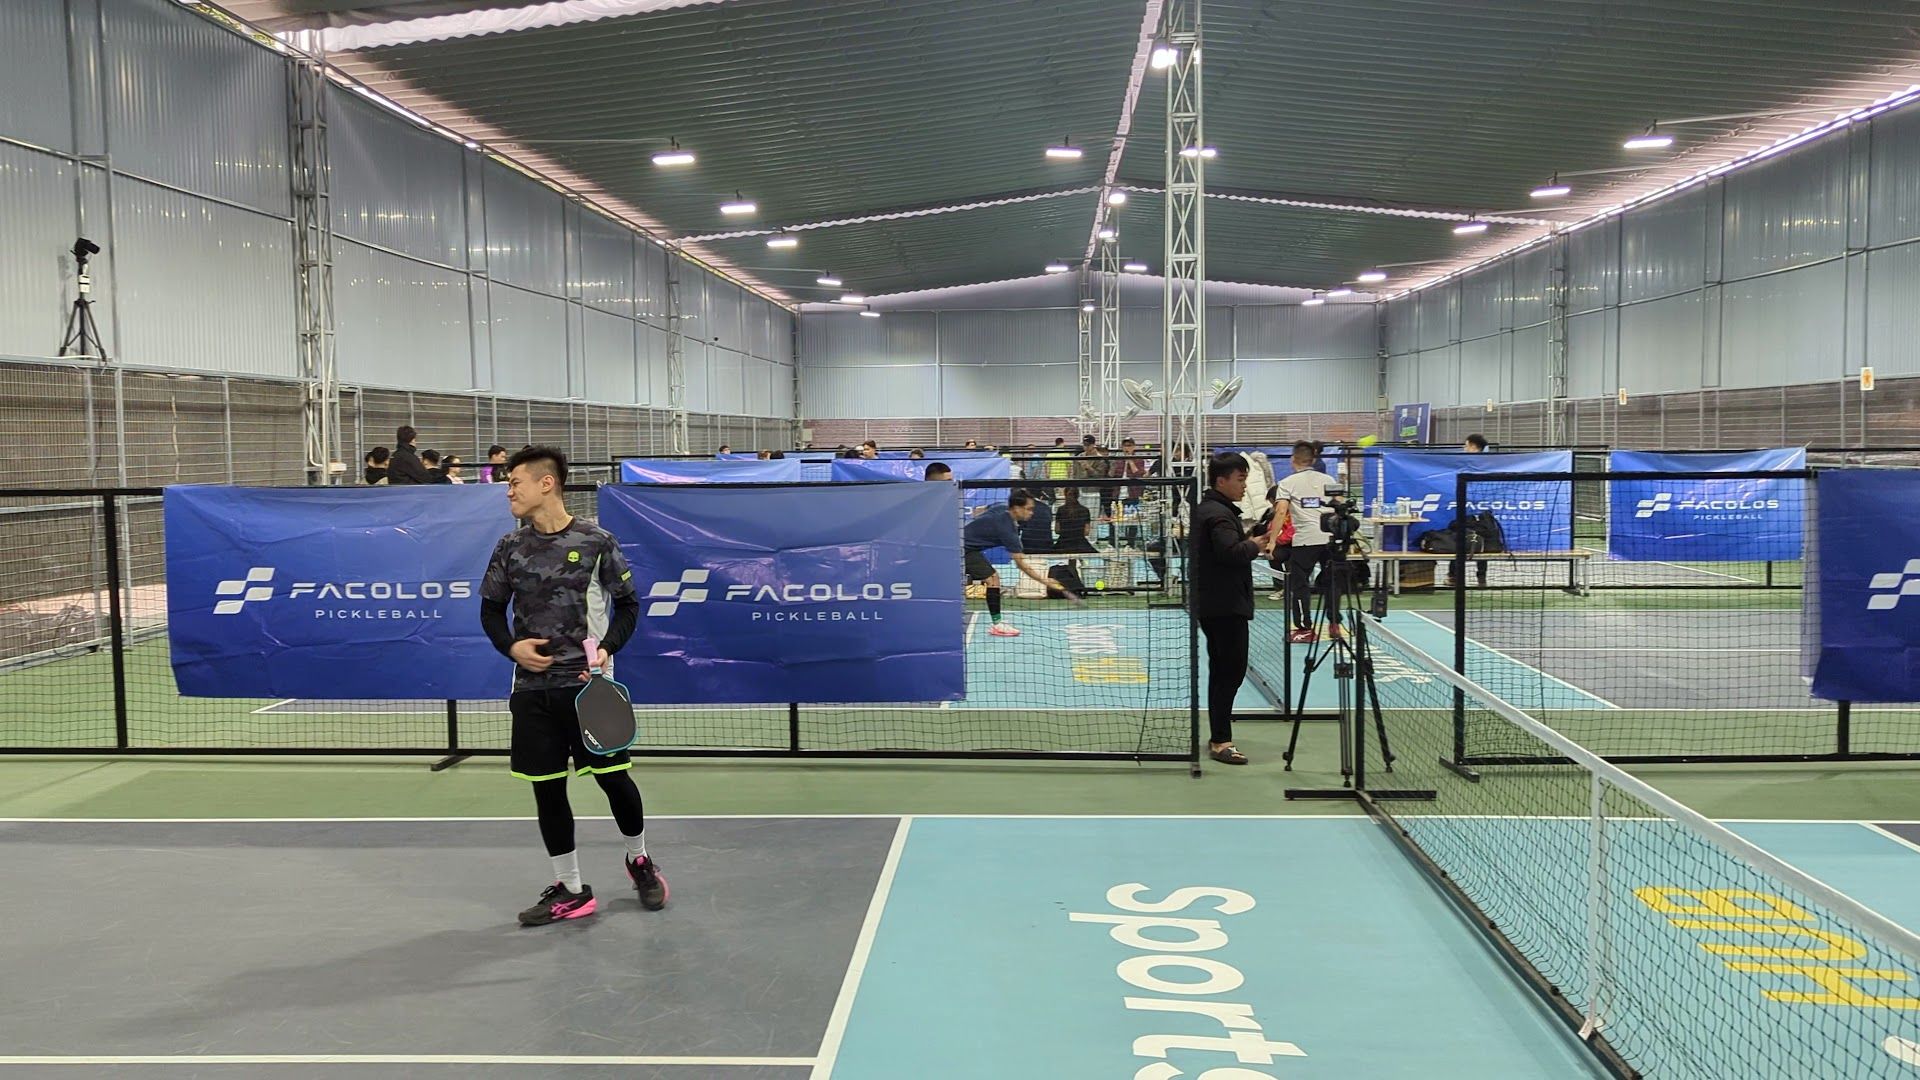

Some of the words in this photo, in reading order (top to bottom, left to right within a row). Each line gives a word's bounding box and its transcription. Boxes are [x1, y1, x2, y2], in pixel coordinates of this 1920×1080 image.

[1678, 499, 1780, 510] FACOLOS
[289, 581, 472, 600] FACOLOS
[725, 582, 913, 602] FACOLOS
[314, 609, 443, 619] PICKLEBALL
[751, 611, 884, 621] PICKLEBALL
[1632, 886, 1920, 1010] HUB
